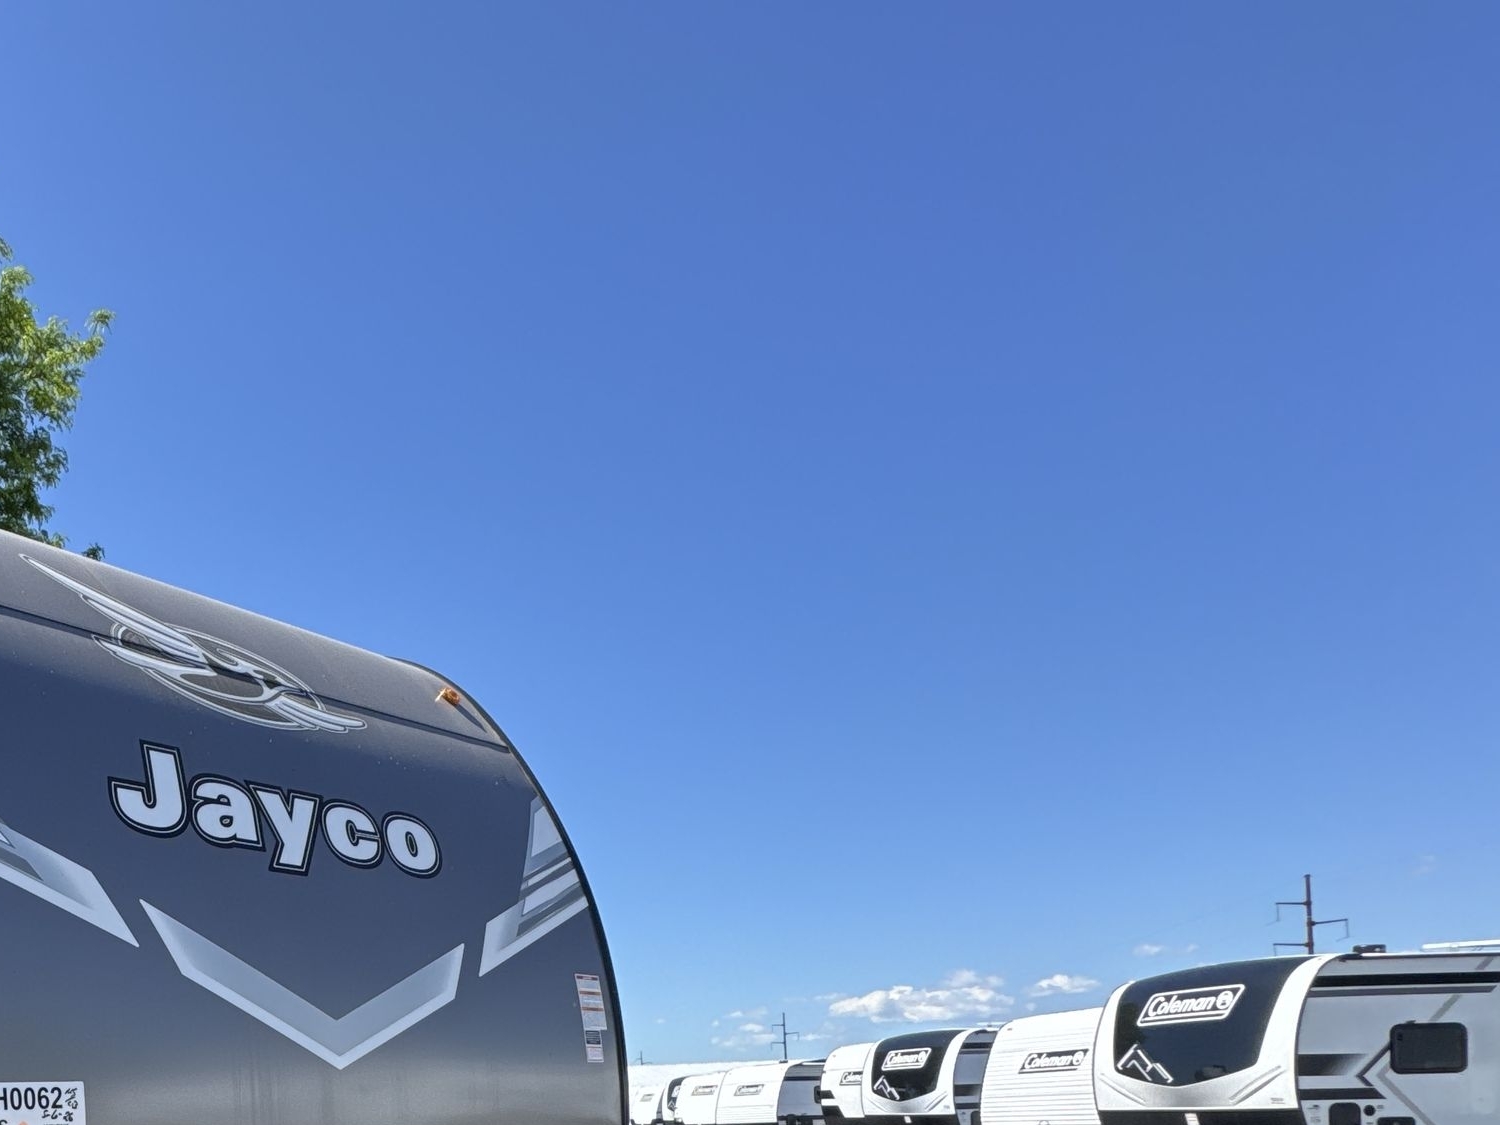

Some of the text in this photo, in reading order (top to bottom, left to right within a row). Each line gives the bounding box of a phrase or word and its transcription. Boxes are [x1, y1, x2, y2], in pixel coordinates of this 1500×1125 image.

[108, 740, 442, 878] Jayco
[1147, 994, 1217, 1017] Coleman
[1024, 1053, 1073, 1069] Coleman
